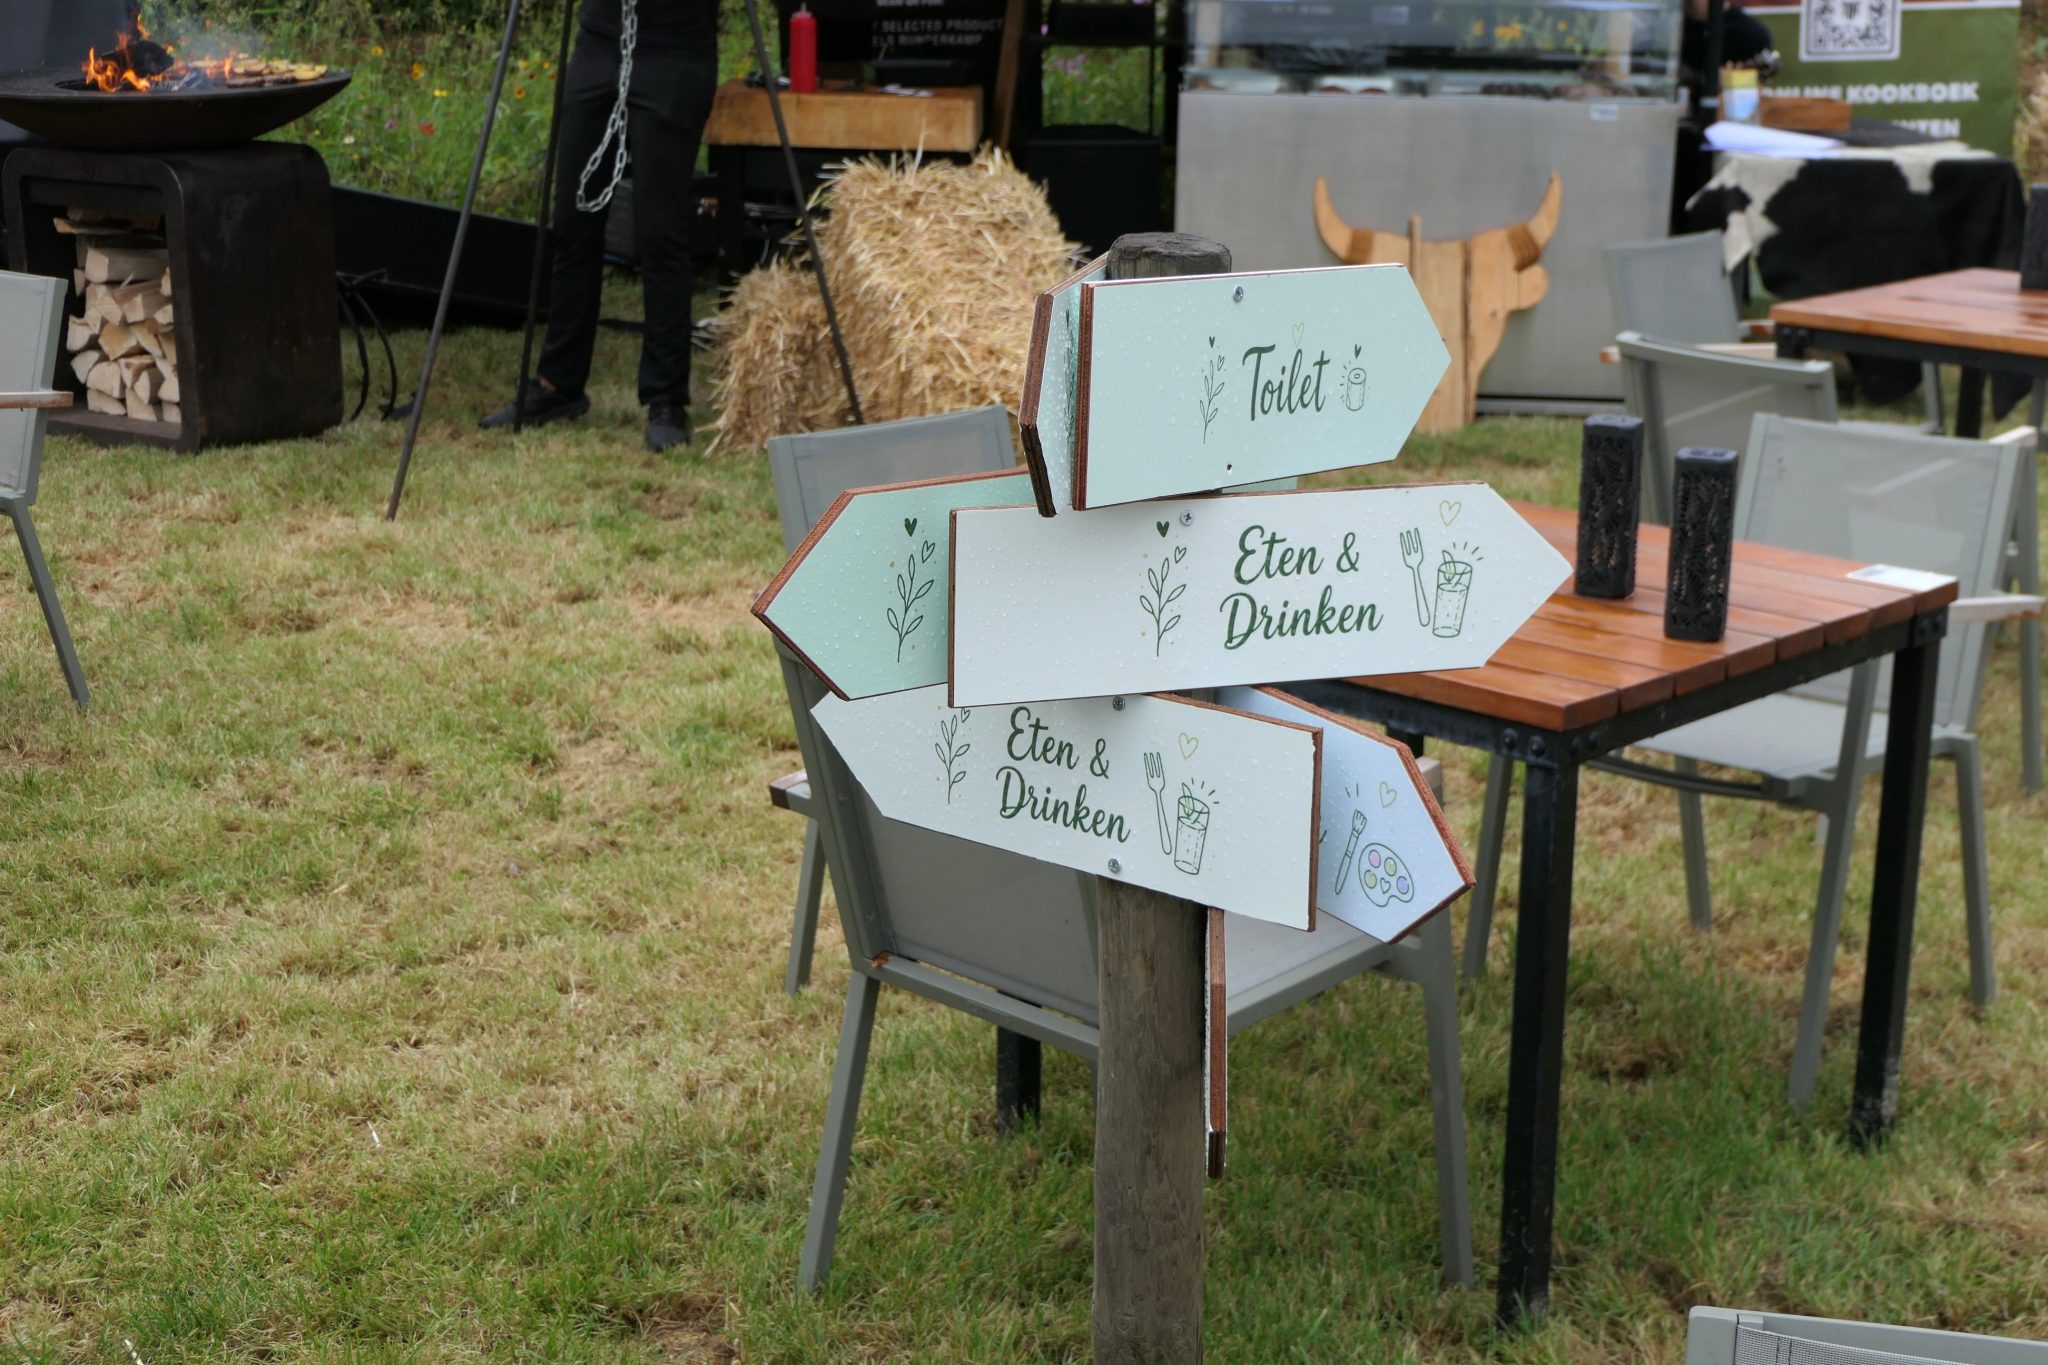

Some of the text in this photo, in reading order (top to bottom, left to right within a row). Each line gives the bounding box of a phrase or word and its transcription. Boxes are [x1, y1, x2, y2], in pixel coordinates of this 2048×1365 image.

[1846, 81, 1980, 104] KOOKBOEK
[1242, 344, 1331, 421] Toilet
[1234, 525, 1360, 585] Eten &
[1219, 585, 1384, 650] Drinken
[1007, 706, 1110, 779] Eten &
[995, 766, 1132, 843] Drinken
